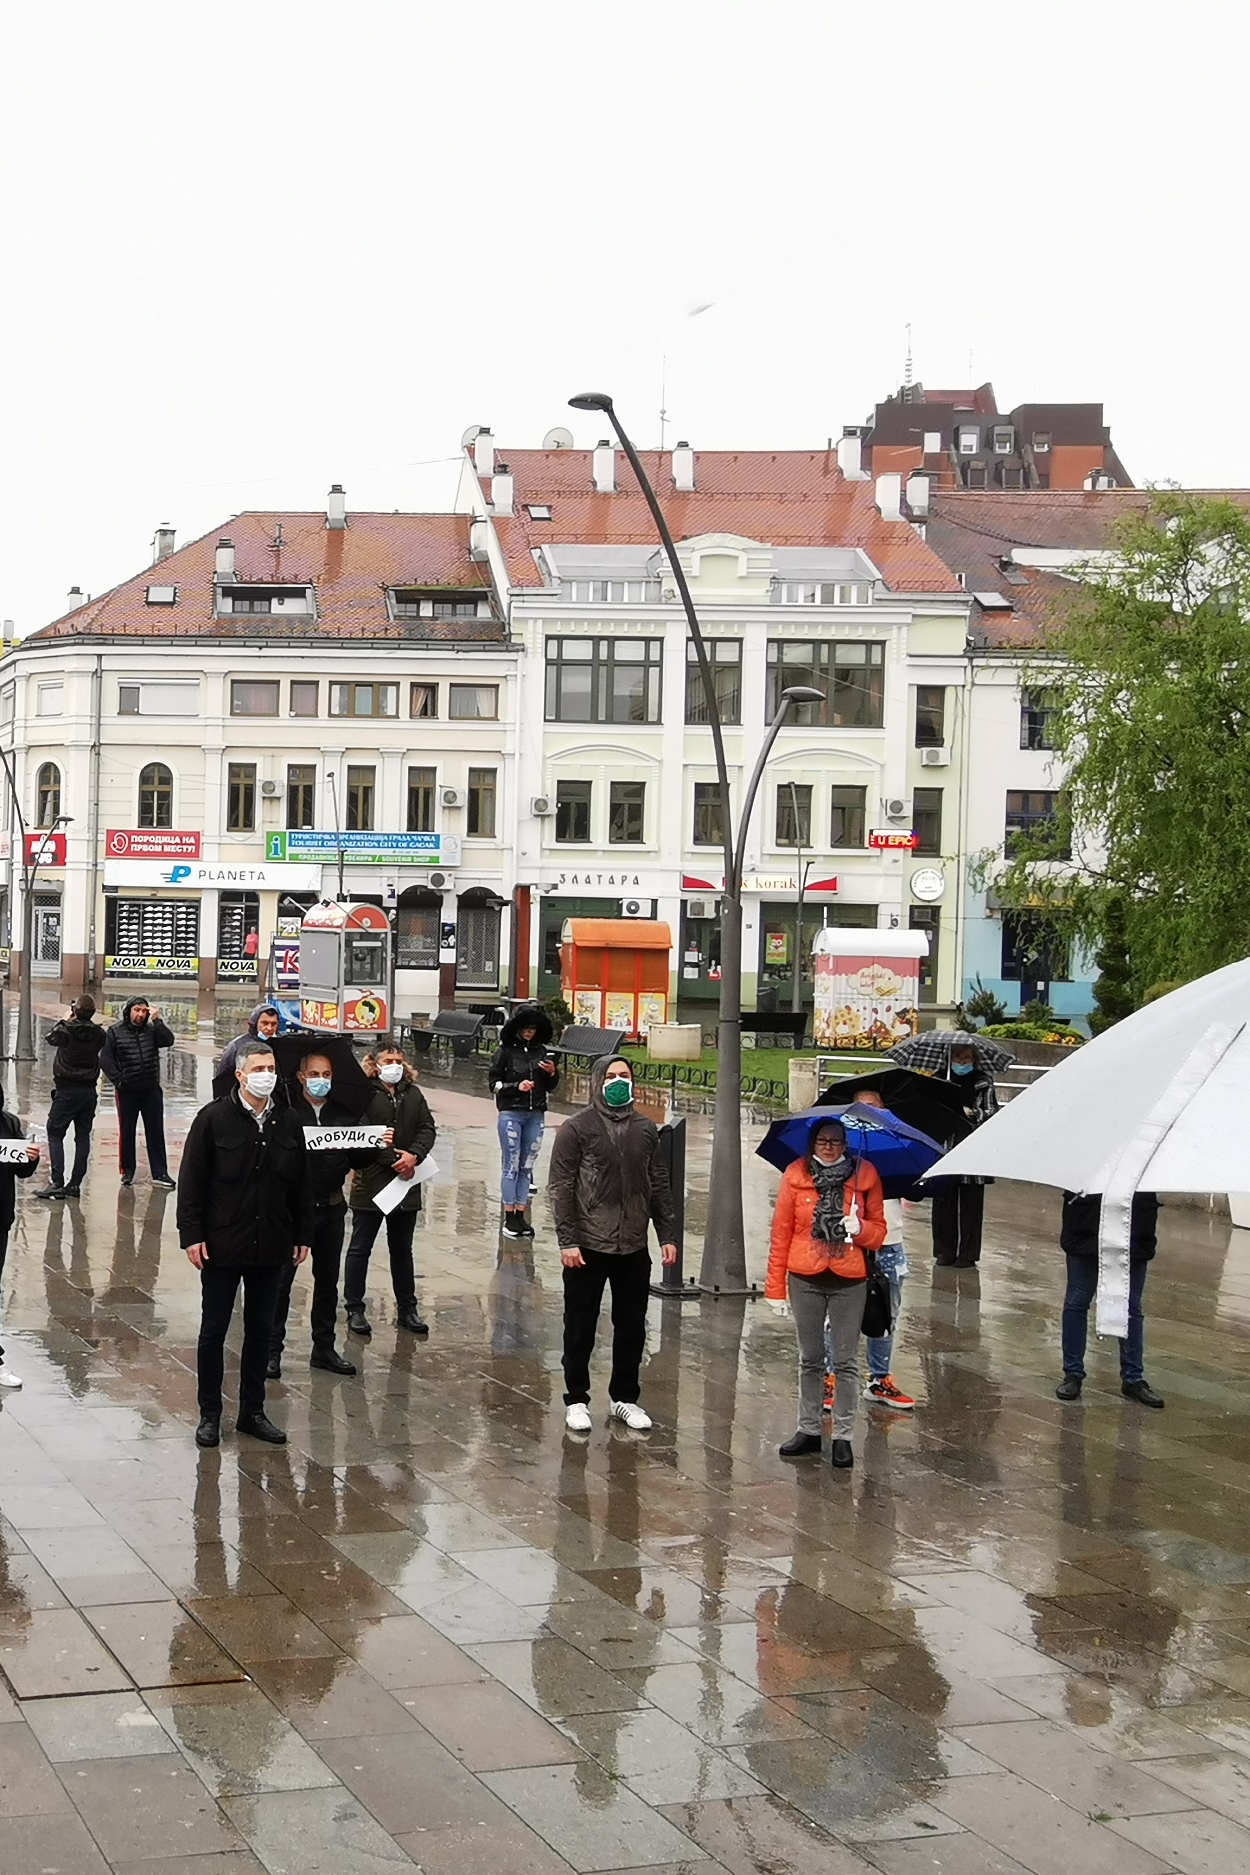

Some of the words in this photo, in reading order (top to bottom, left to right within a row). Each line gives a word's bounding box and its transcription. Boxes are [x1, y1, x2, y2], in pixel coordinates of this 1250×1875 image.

[131, 835, 181, 843] ПОРОДИЦА
[199, 870, 266, 881] PLANETA
[559, 873, 639, 885] ЗЛАТАРА
[756, 877, 797, 889] korak
[112, 958, 146, 967] NOVA
[156, 959, 191, 968] NOVA
[220, 961, 254, 970] NOVA
[307, 1131, 365, 1149] ПРОБУДИ
[368, 1135, 383, 1147] СЕ
[10, 1149, 25, 1162] СЕ
